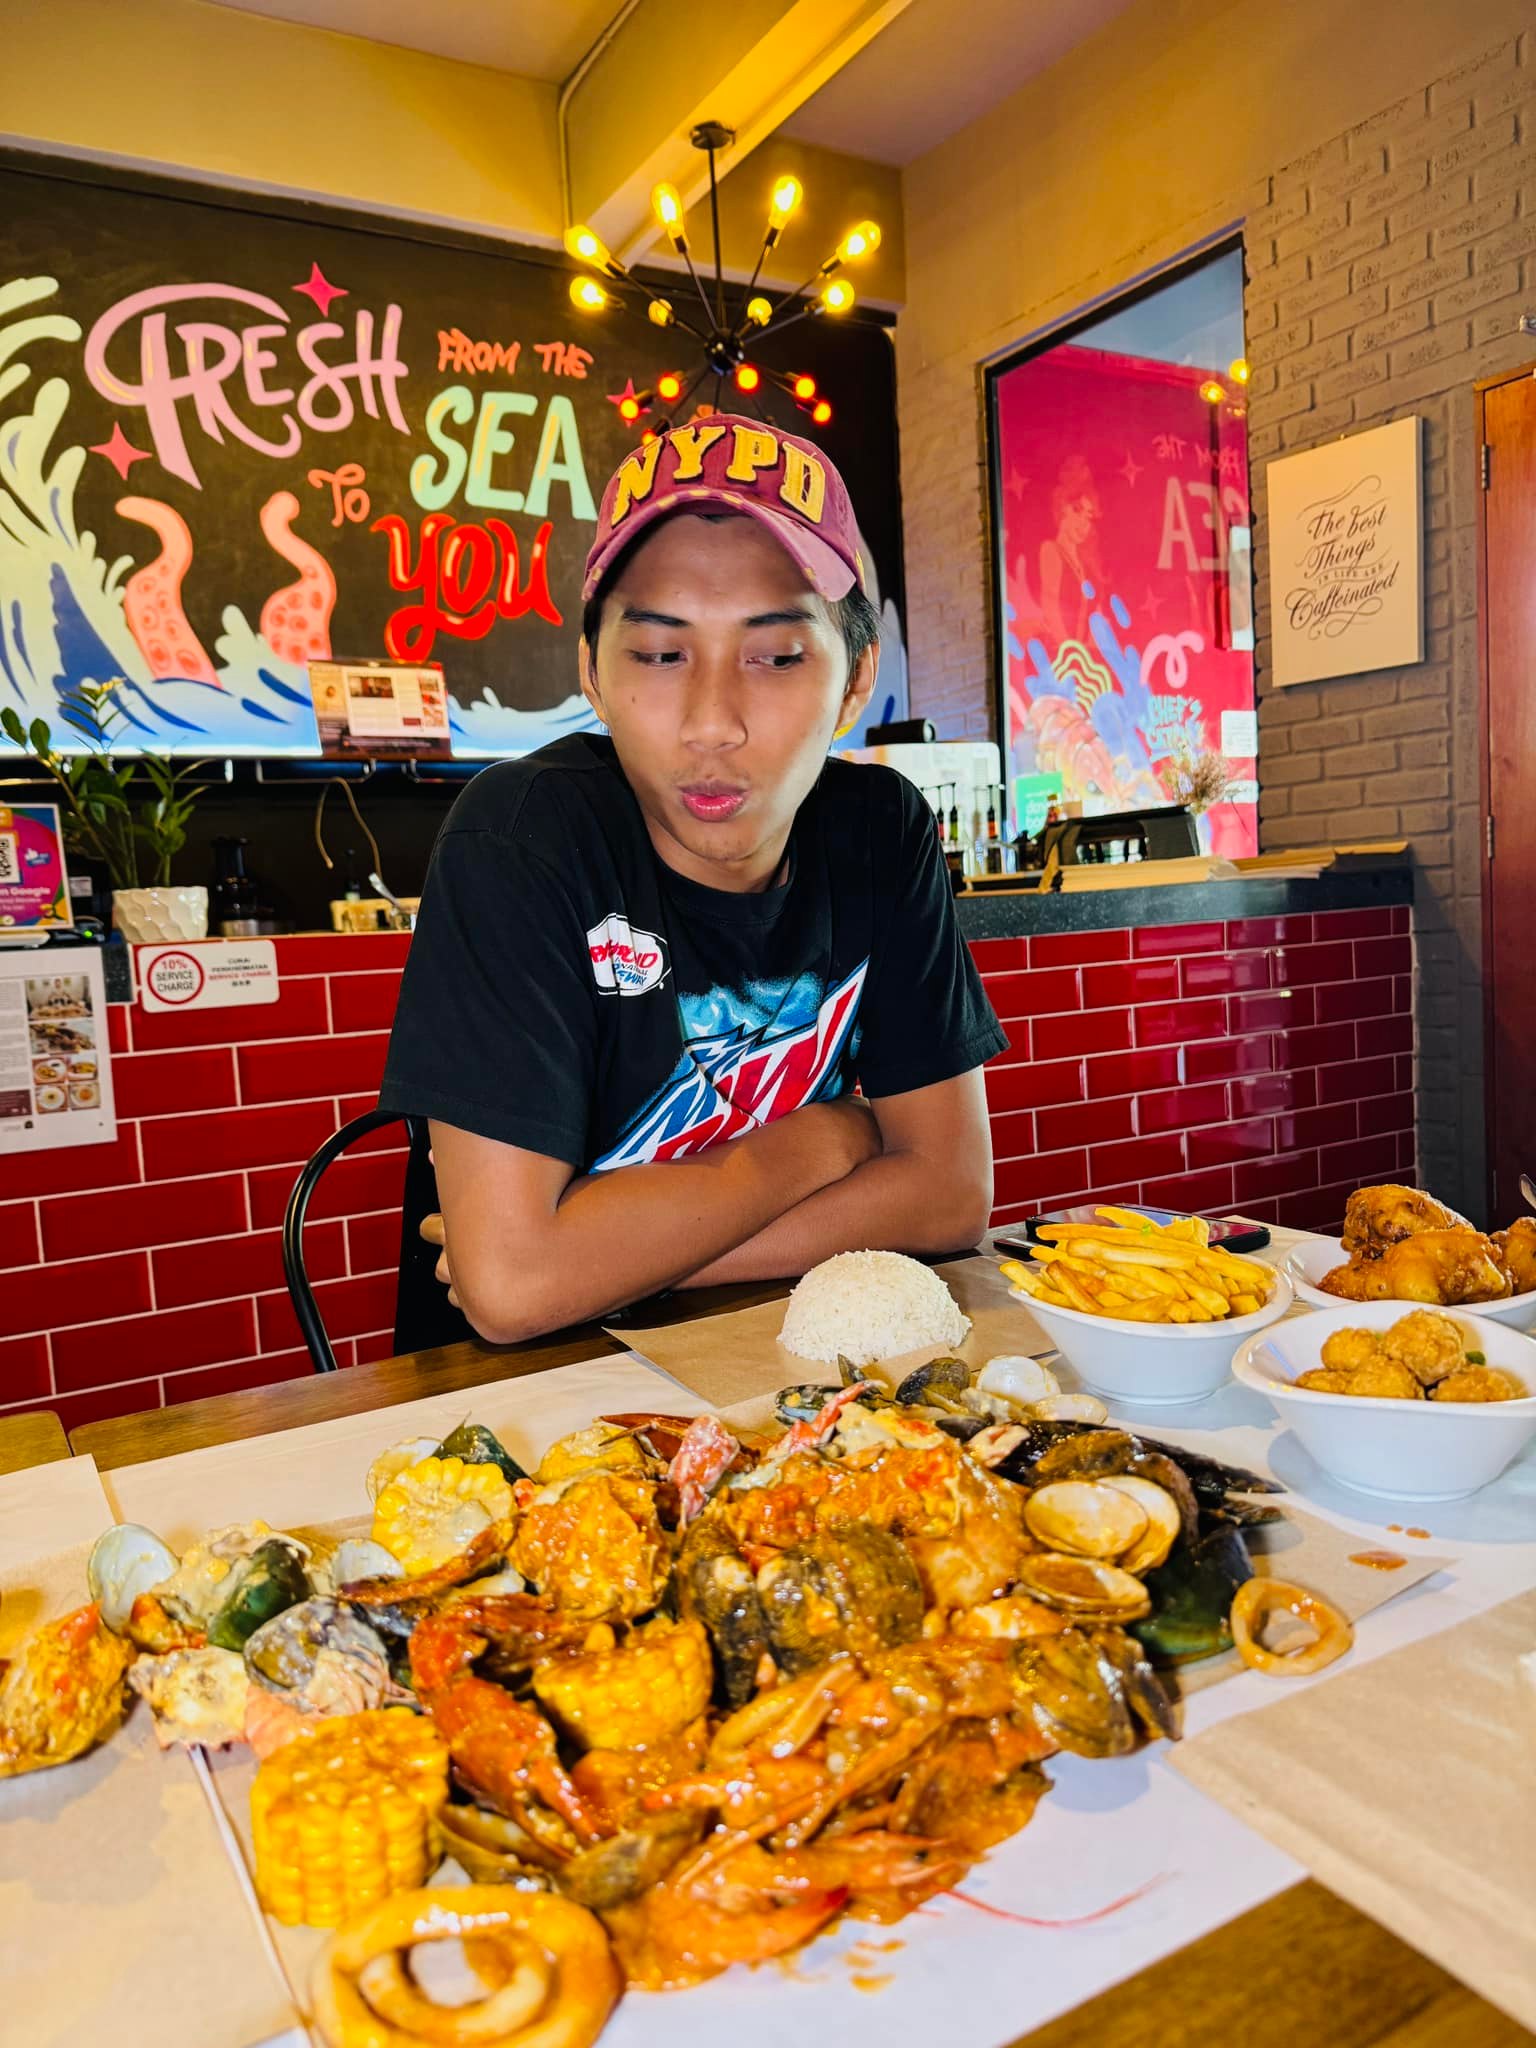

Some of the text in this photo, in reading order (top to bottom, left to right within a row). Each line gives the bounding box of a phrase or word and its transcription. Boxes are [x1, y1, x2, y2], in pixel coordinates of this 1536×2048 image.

[436, 327, 595, 379] FROM THE
[84, 282, 411, 490] FRESH
[410, 385, 598, 521] SEA
[611, 424, 826, 527] NYPD
[1346, 503, 1387, 539] best
[1303, 532, 1377, 579] Things
[369, 514, 563, 663] YOU
[1285, 561, 1400, 632] Caffeinated
[155, 969, 194, 981] SERVICE
[156, 981, 194, 993] CHARGE
[161, 958, 188, 970] 10%
